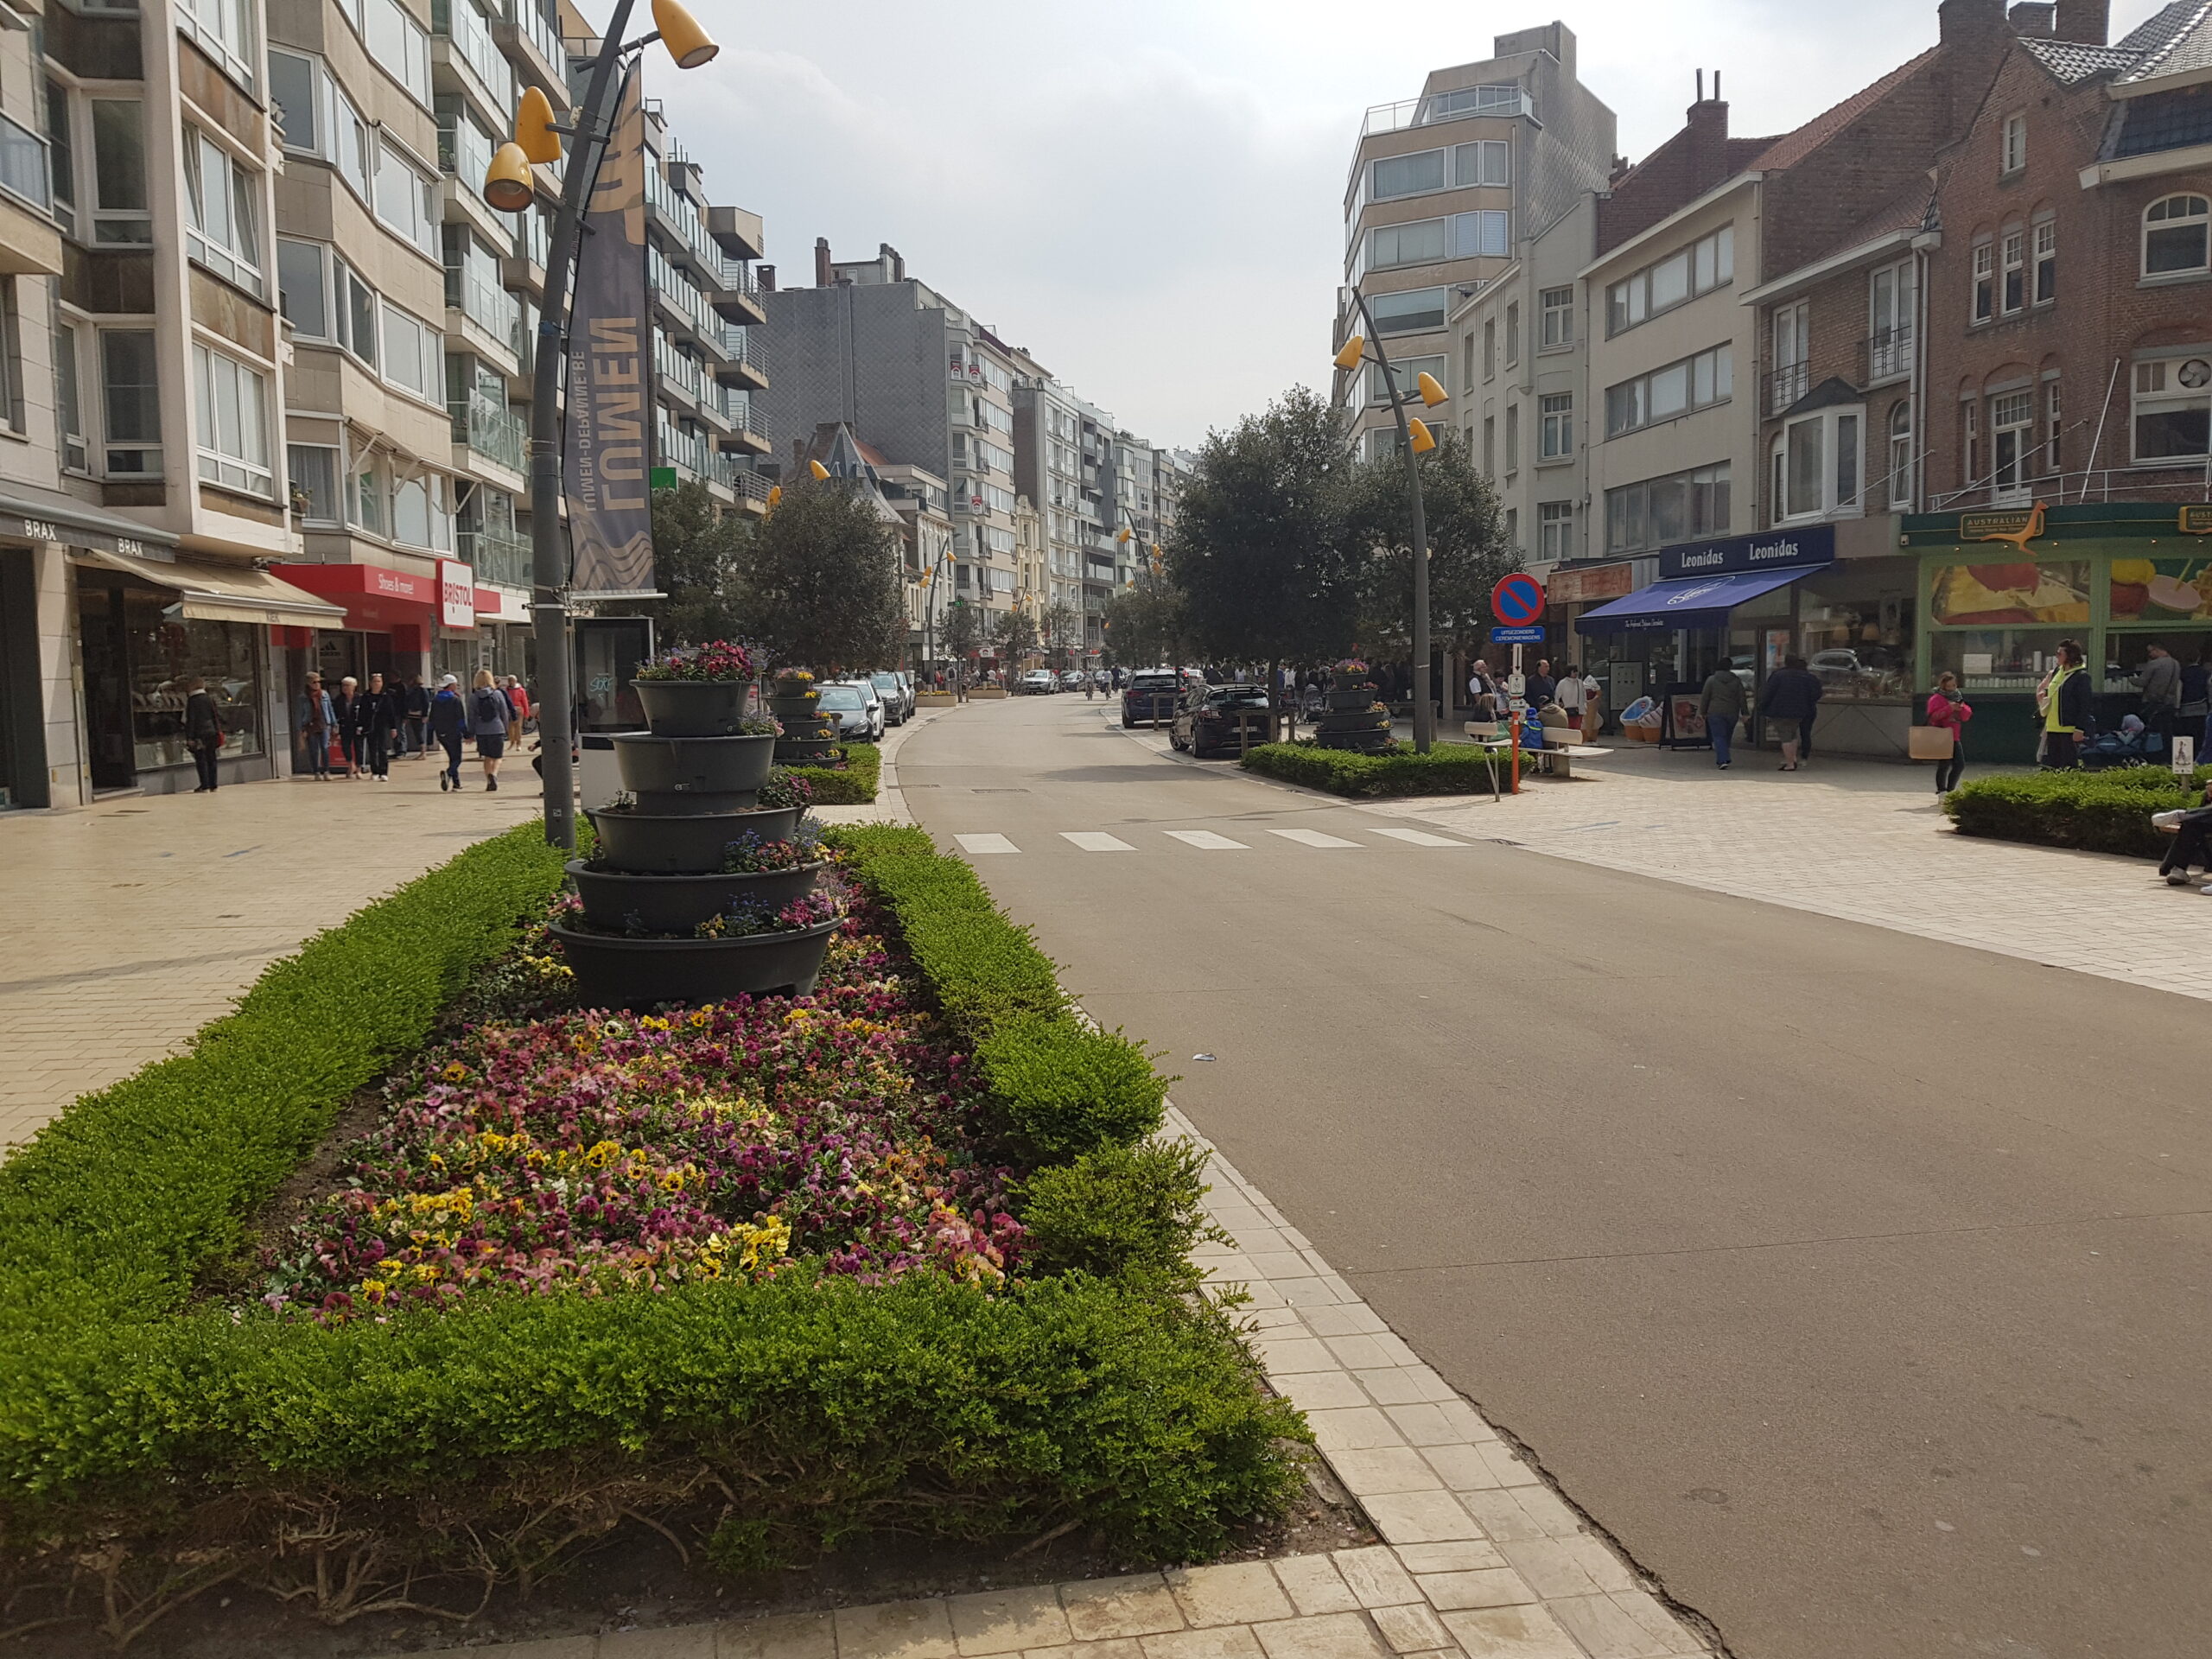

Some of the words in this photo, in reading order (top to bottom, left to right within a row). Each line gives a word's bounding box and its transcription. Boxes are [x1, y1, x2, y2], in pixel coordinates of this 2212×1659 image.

[24, 519, 57, 541] BRAX
[1967, 517, 2028, 525] AUSTRALIAN
[118, 537, 143, 556] BRAX
[1749, 537, 1799, 561] Leonidas
[1681, 548, 1724, 568] Leonidas
[378, 573, 394, 592] Shoes
[444, 582, 472, 607] BRISTOL
